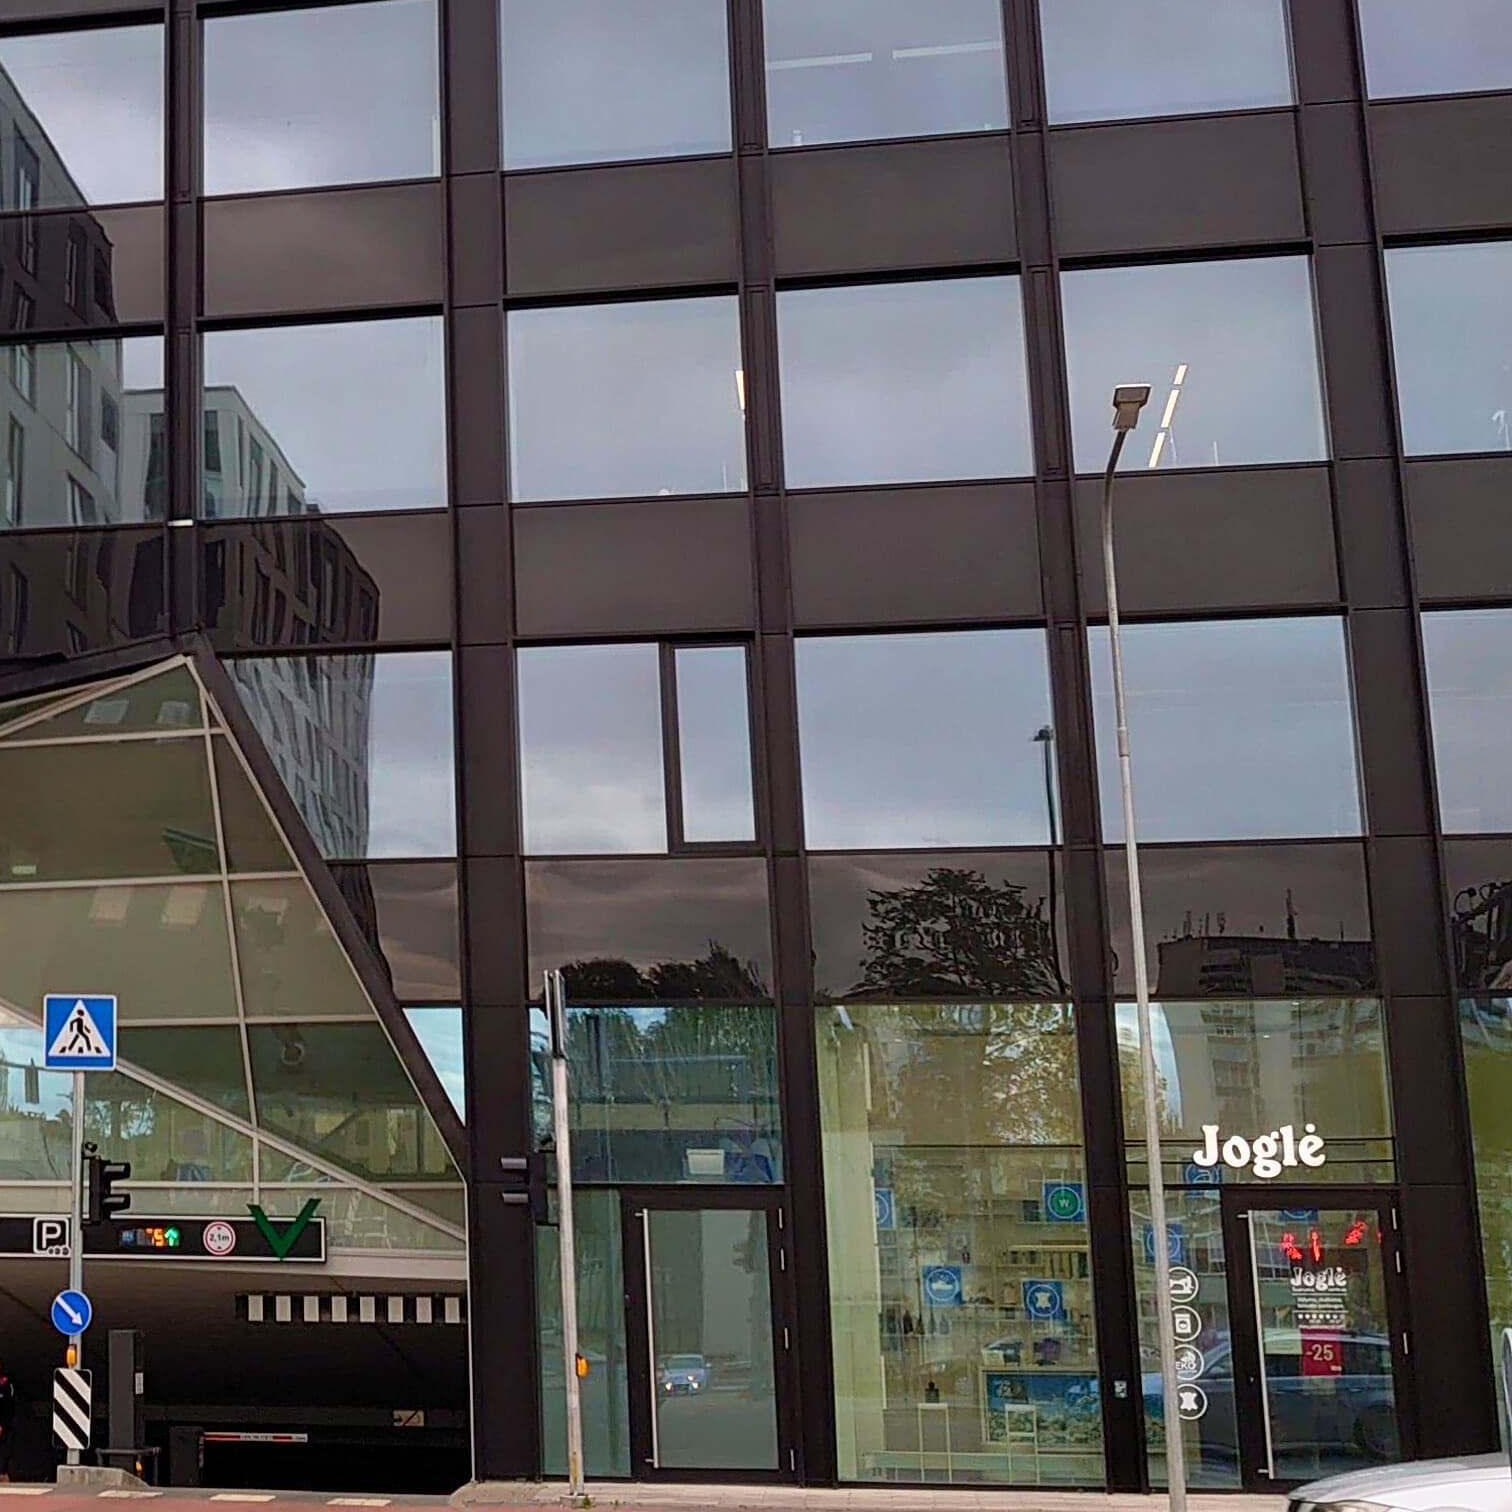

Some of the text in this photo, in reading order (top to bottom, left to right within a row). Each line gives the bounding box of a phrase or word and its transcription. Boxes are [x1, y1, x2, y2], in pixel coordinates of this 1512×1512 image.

[1193, 1123, 1326, 1178] Joglė
[42, 1223, 62, 1249] P
[209, 1233, 230, 1244] 2,1m
[1290, 1267, 1347, 1291] Joglė
[1176, 1361, 1196, 1370] EKO
